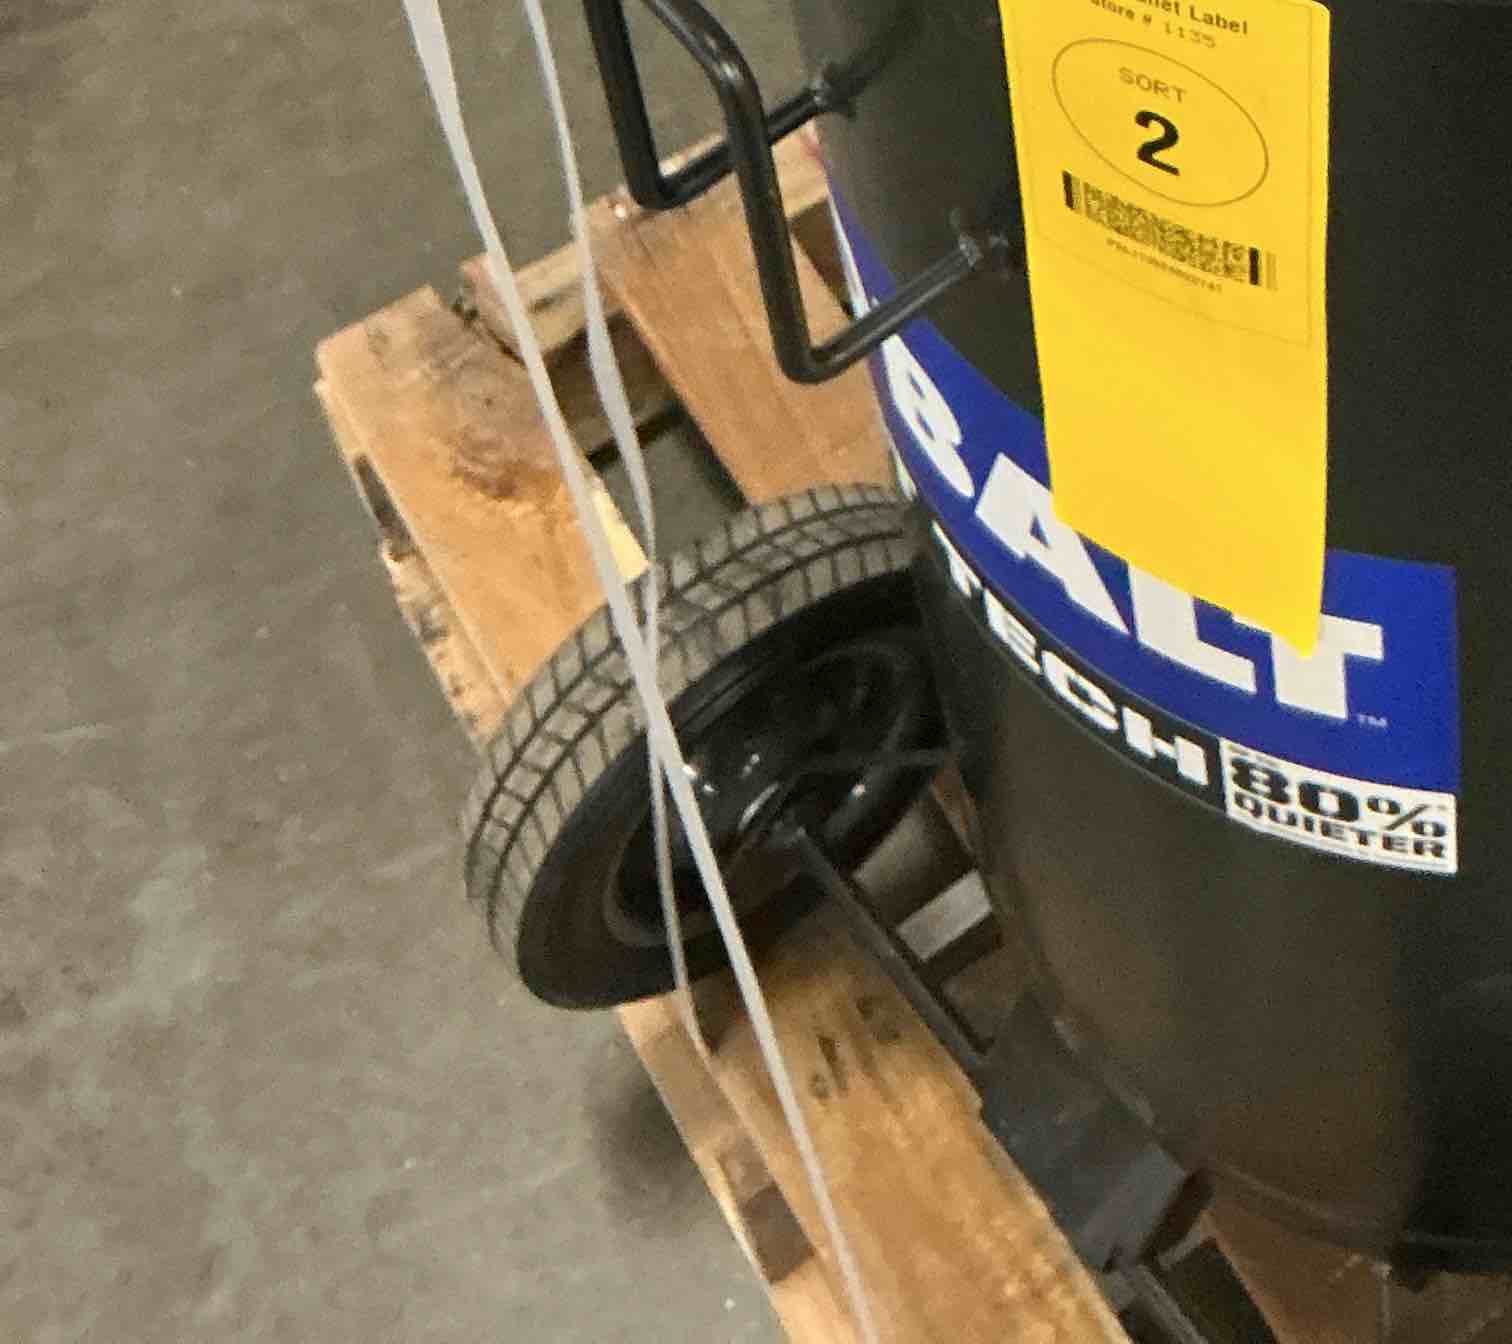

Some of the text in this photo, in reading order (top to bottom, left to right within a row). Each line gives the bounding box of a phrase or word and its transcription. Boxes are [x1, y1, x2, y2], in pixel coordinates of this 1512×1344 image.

[1189, 5, 1248, 35] Label
[1117, 66, 1188, 103] SORT
[1135, 109, 1181, 177] 2
[1231, 757, 1447, 839] 80%
[1234, 791, 1444, 857] QUIETER
